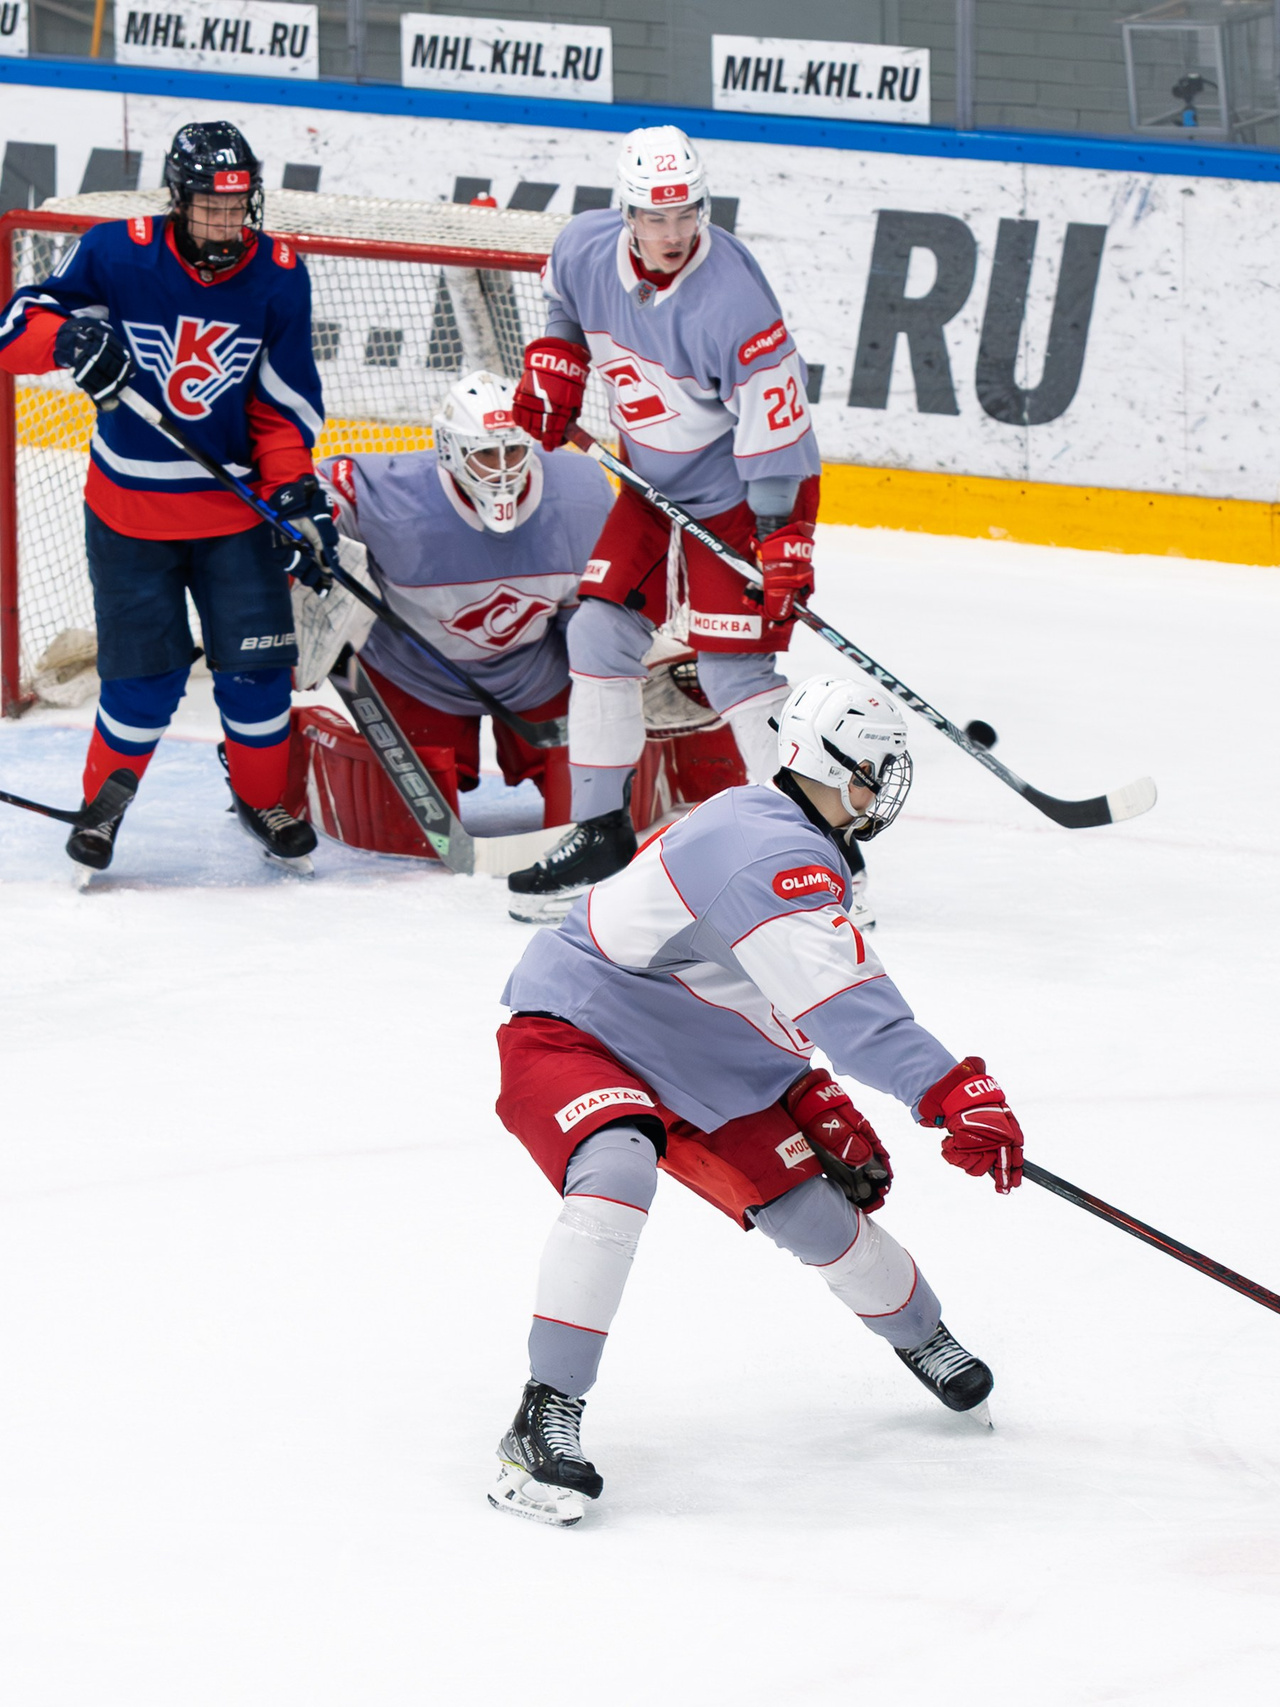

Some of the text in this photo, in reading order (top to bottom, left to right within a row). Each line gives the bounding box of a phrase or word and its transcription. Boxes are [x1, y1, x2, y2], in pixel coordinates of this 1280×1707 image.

[124, 11, 309, 58] MHL.KHL.RU
[411, 34, 604, 82] MHL.KHL.RU
[722, 55, 920, 102] MHL.KHL.RU
[654, 153, 678, 173] 22
[762, 374, 804, 431] 22
[494, 502, 514, 522] 30
[654, 499, 688, 526] ACE
[685, 522, 724, 553] prime
[693, 614, 752, 633] МОСКВА
[787, 742, 800, 767] 7
[831, 915, 866, 965] 7
[565, 1091, 644, 1123] СПАРТАК
